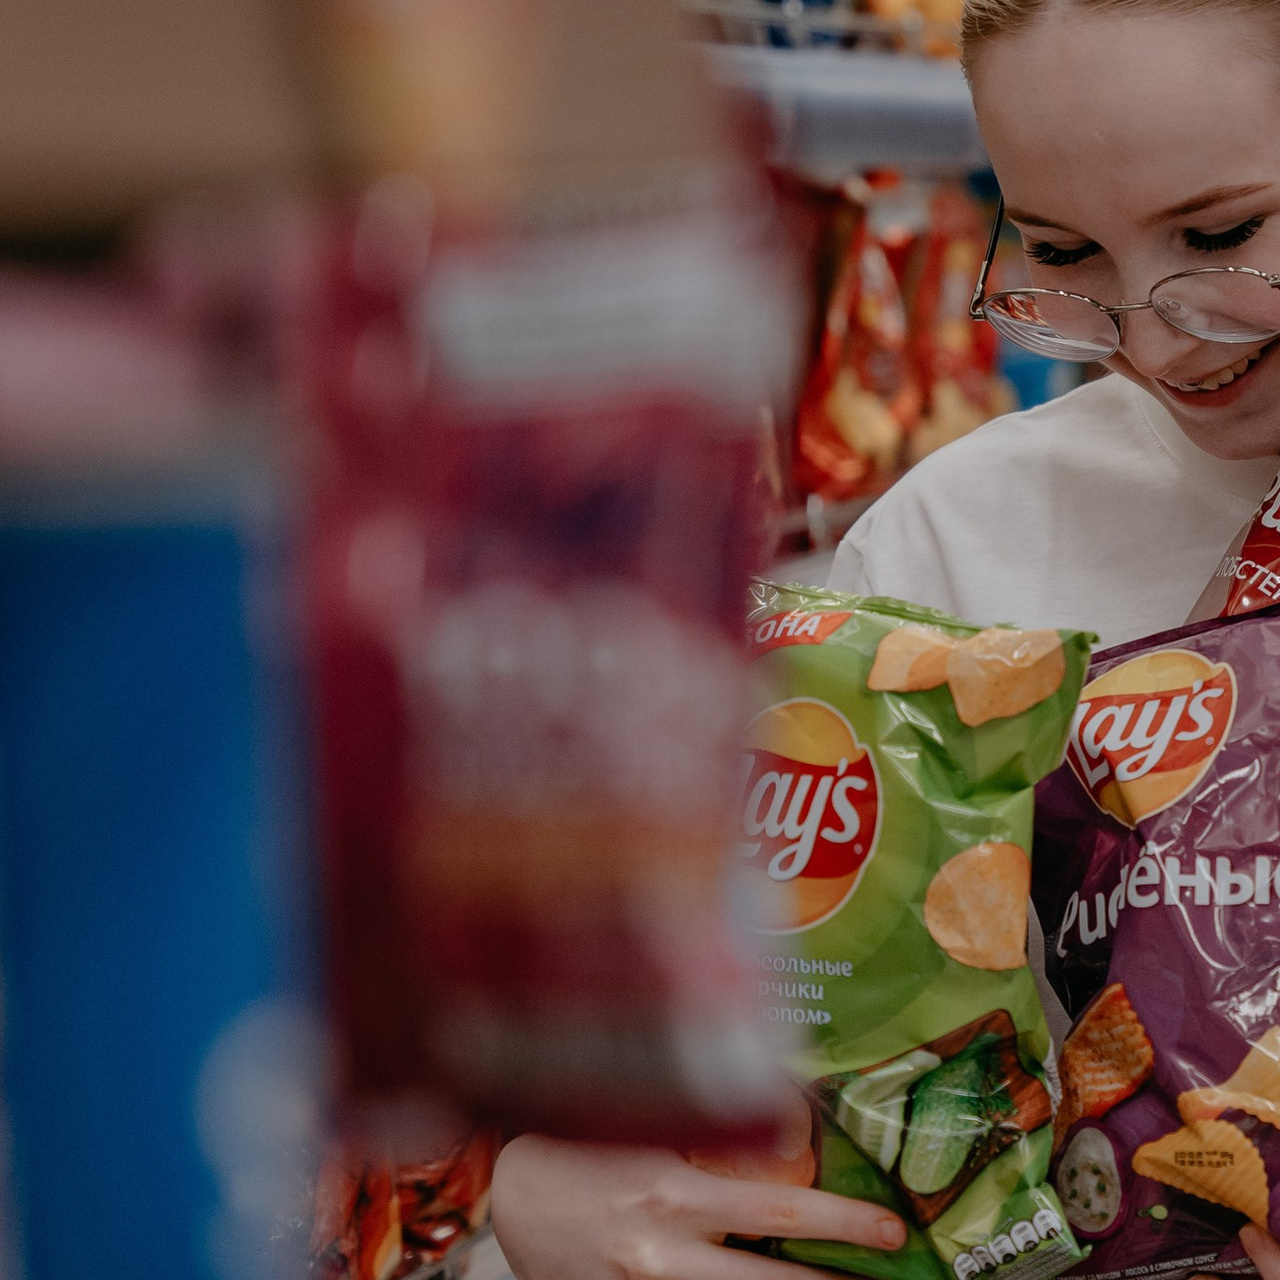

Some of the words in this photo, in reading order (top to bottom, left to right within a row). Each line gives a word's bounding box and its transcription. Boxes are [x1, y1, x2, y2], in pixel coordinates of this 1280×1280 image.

[754, 614, 822, 643] ОНА
[1066, 679, 1225, 790] Lay's
[754, 956, 854, 978] сольные
[757, 980, 824, 1001] рчики
[766, 1006, 832, 1026] опом»
